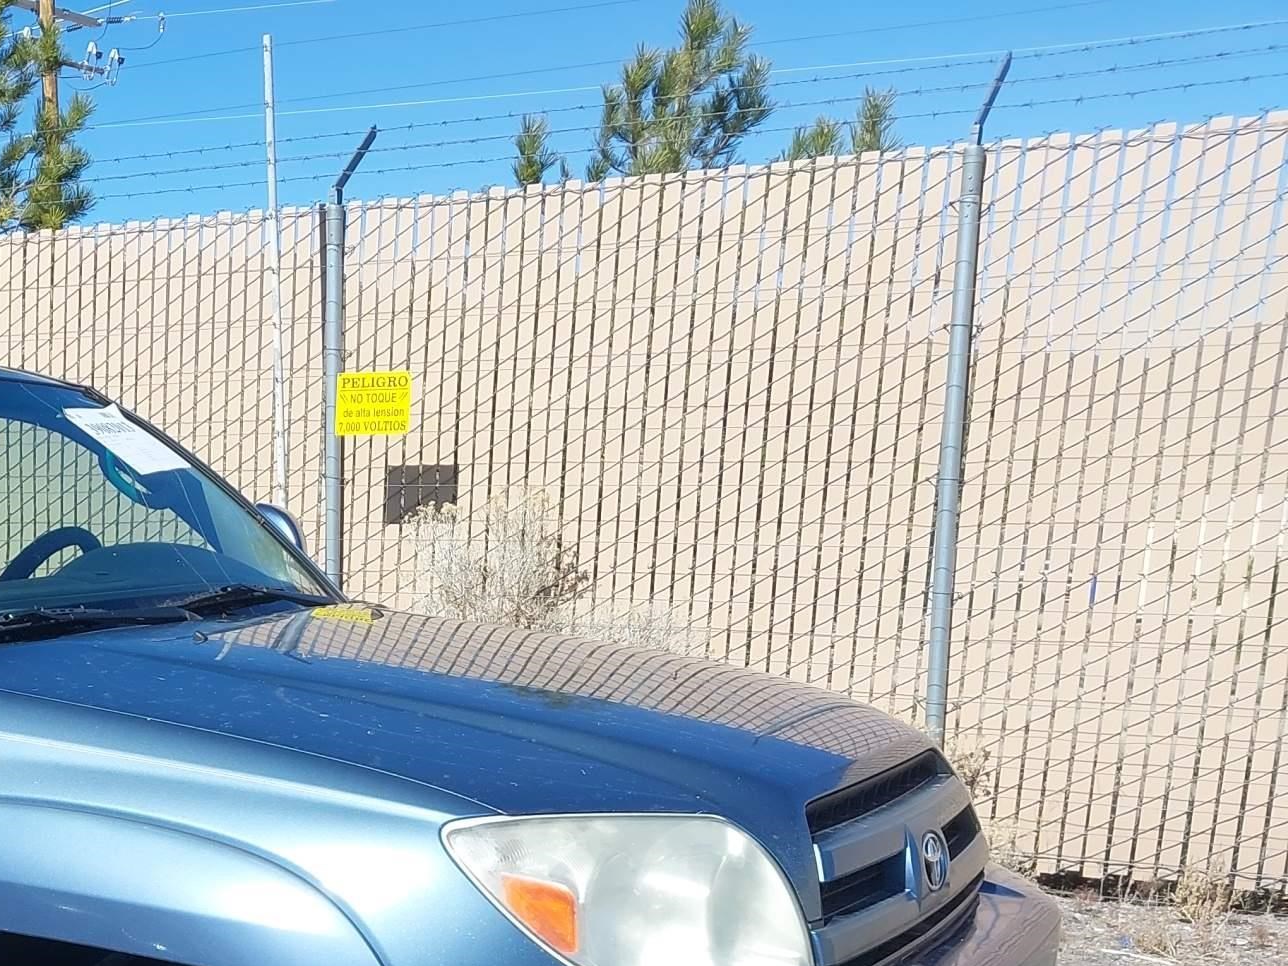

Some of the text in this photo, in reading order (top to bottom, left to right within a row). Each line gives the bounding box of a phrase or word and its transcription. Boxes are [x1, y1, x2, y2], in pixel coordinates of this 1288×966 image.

[342, 376, 408, 388] PELIGRO
[350, 392, 397, 404] NO TOQUE
[343, 408, 354, 418] de
[356, 407, 371, 418] alta
[364, 421, 406, 432] VOLTIOS
